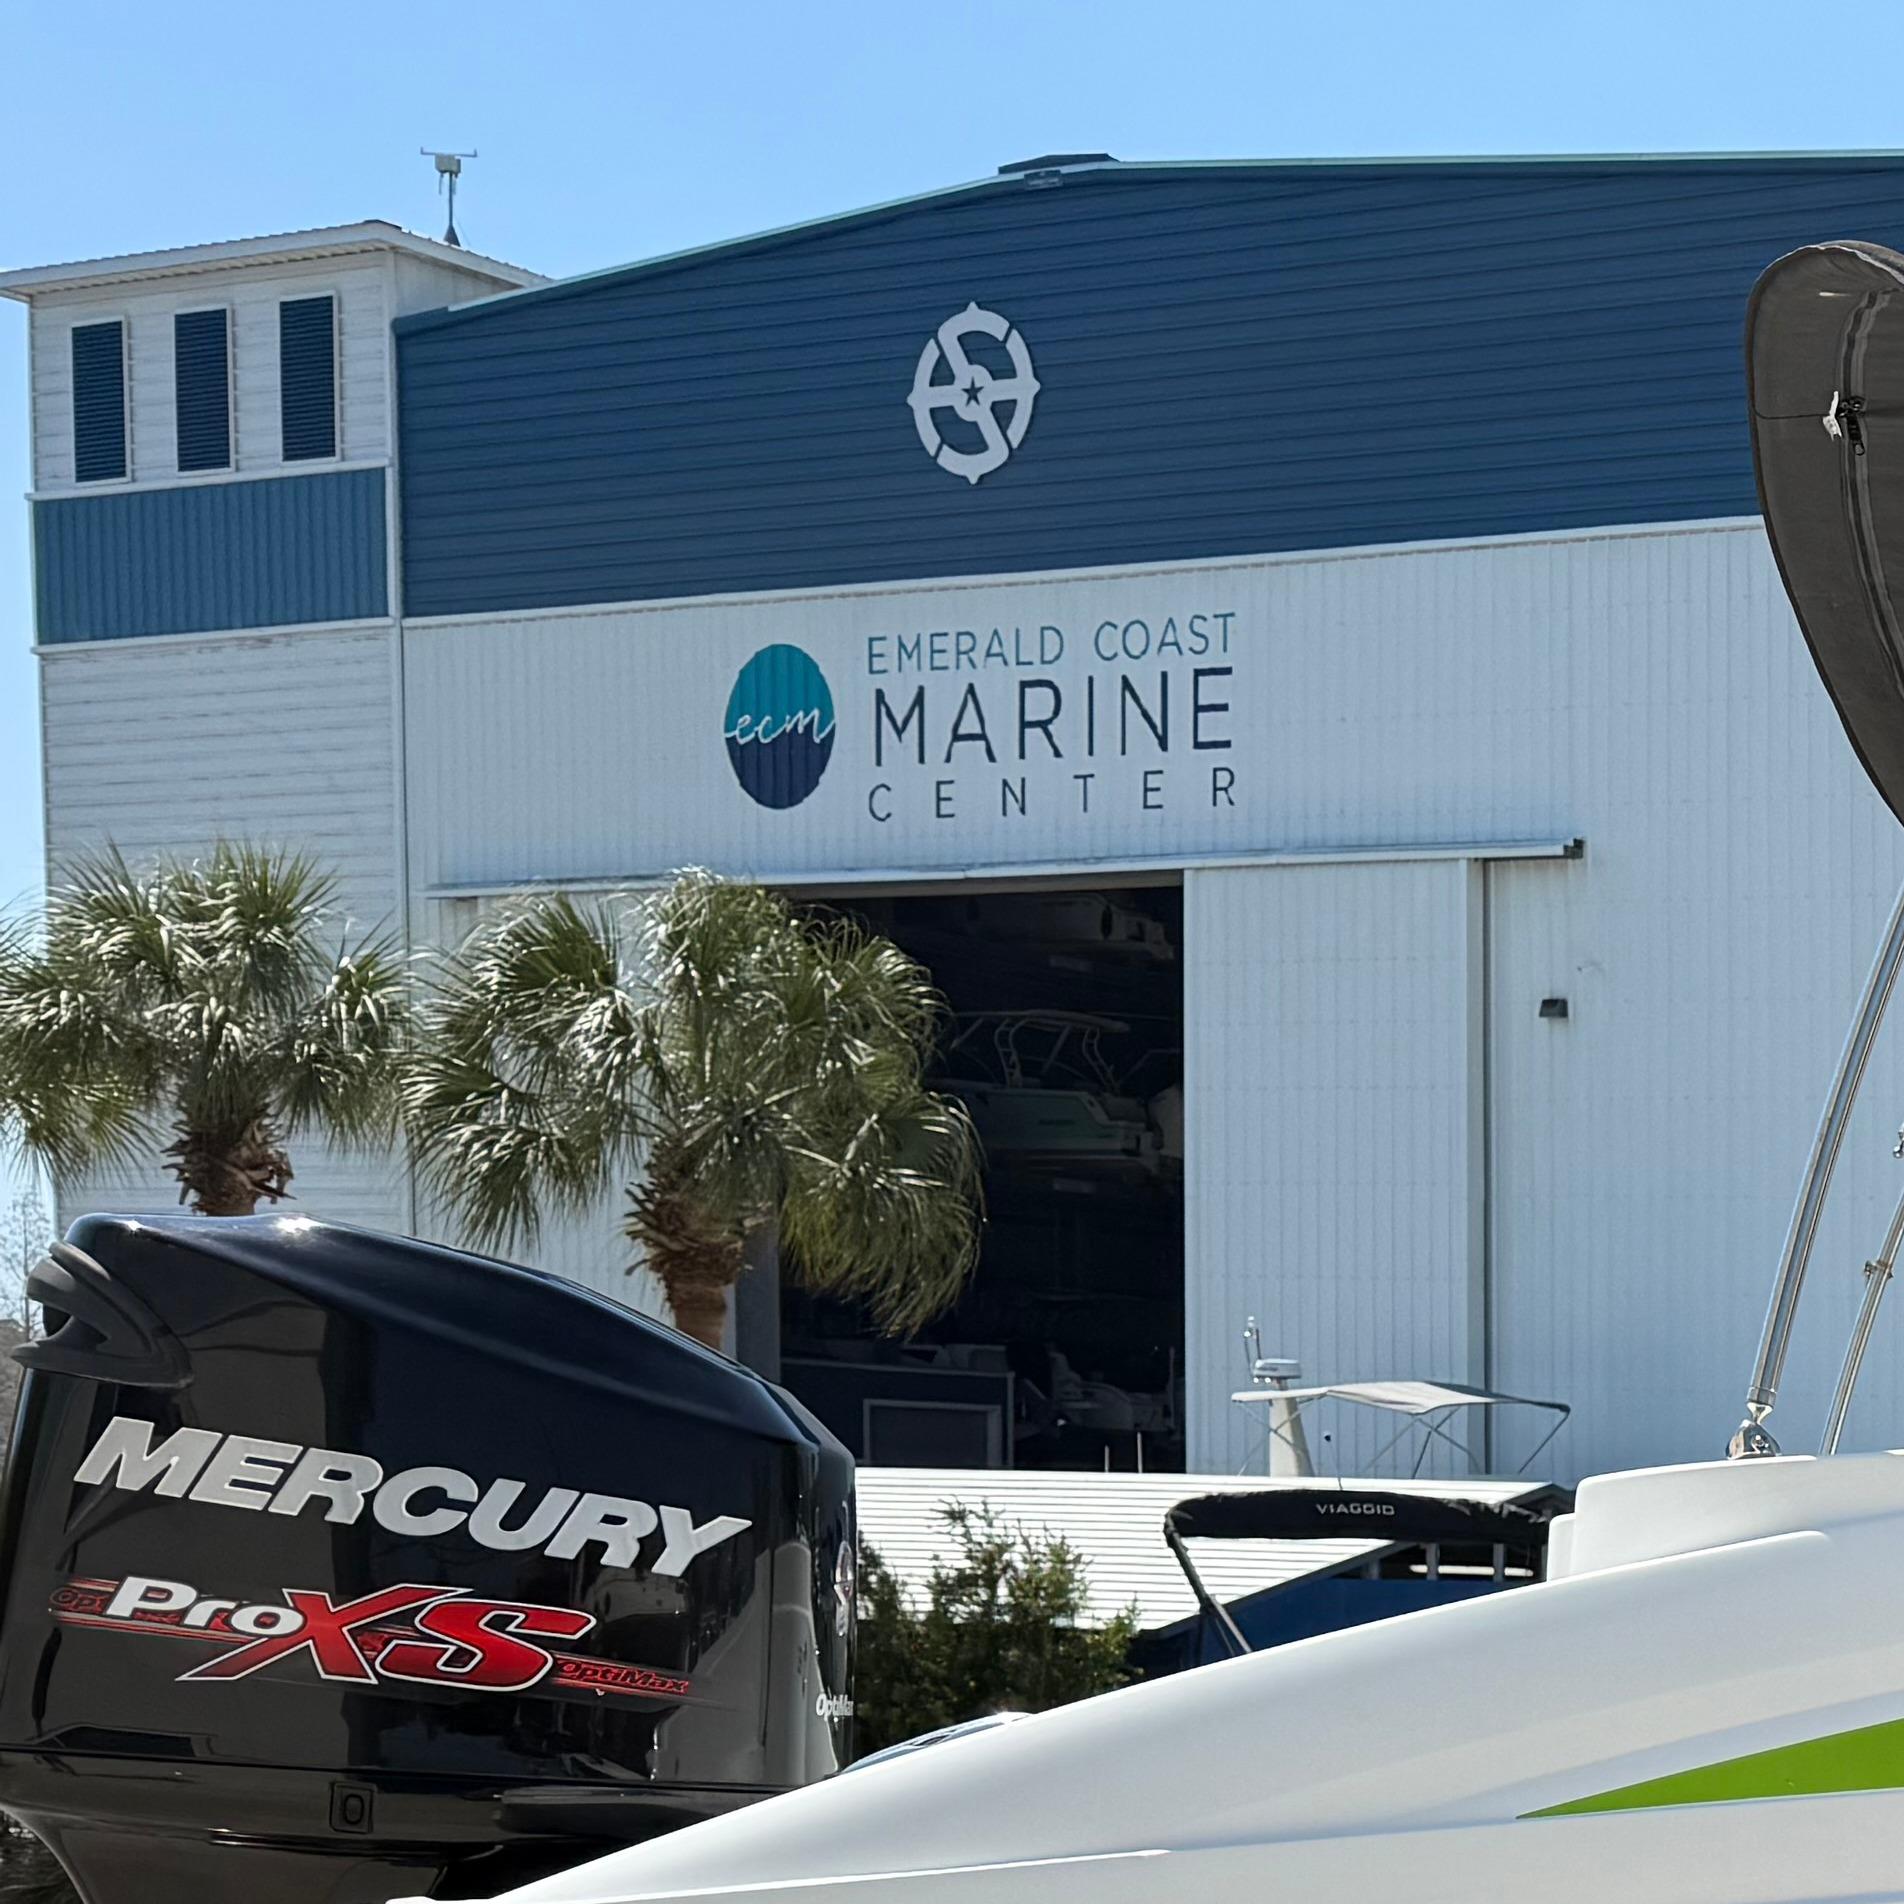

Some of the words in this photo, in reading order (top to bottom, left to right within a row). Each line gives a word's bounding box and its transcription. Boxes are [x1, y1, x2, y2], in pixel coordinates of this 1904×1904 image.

[867, 625, 1064, 675] EMERALD
[1093, 611, 1237, 662] COAST
[723, 706, 836, 746] ecm
[874, 665, 1234, 767] MARINE
[868, 766, 1236, 822] CENTER
[74, 1415, 754, 1579] MERCURY
[1315, 1503, 1396, 1516] VIAGGIO
[558, 1659, 690, 1696] OptiMax
